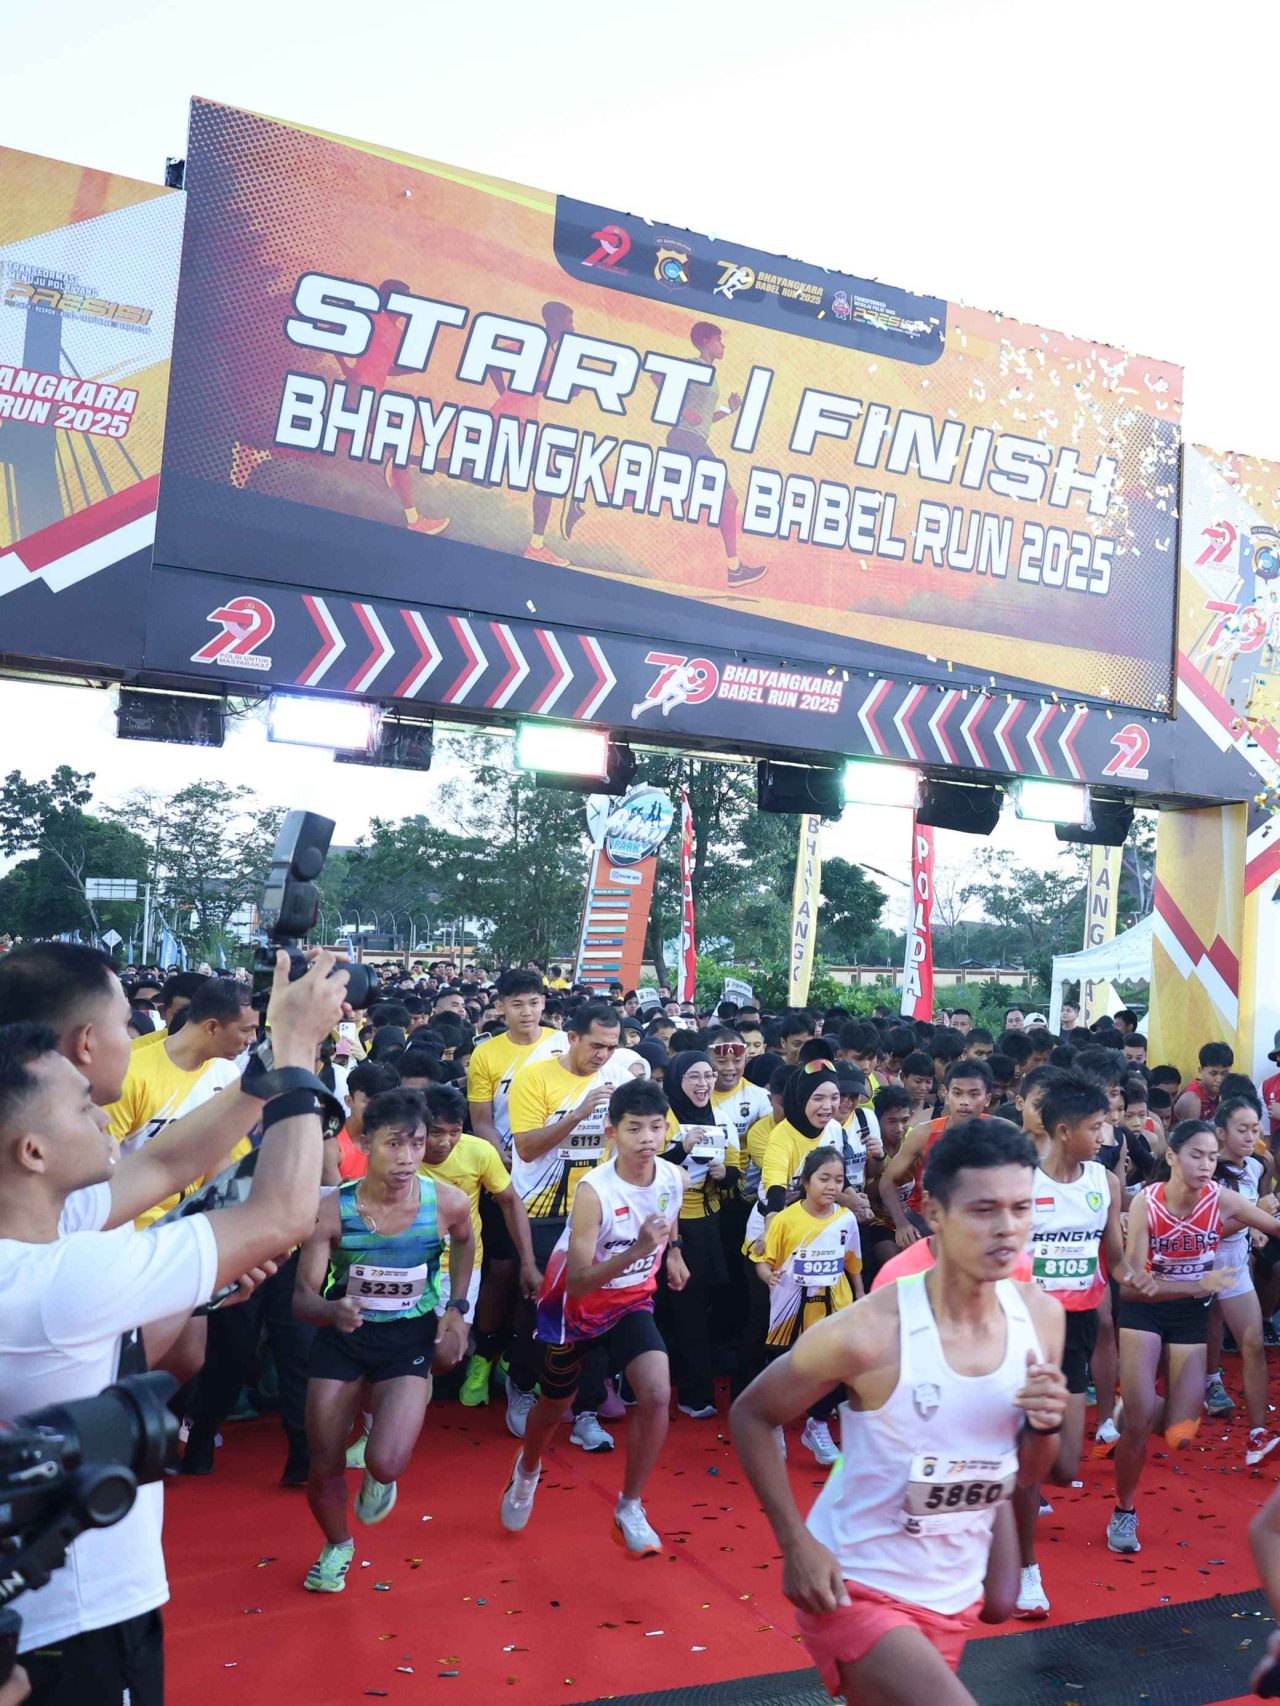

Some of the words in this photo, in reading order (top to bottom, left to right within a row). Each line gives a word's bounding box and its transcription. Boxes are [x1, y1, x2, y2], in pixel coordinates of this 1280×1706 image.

[8, 271, 46, 288] MENUJU
[757, 272, 824, 297] BHAYANGKARA
[6, 282, 153, 326] PRESISI
[755, 281, 779, 295] BABEL
[799, 292, 822, 305] 2025
[287, 273, 714, 425] START
[789, 388, 1119, 515] FINISH
[54, 404, 131, 439] 2025
[274, 371, 727, 527] BHAYANGKARA
[742, 466, 906, 562] BABEL
[912, 499, 1013, 578] RUN
[1017, 522, 1115, 595] 2025
[220, 658, 269, 669] MASYARAKAT
[723, 665, 843, 697] BHAYANGKARA
[718, 682, 764, 704] BABEL
[767, 689, 798, 708] RUN
[799, 694, 840, 714] 2025
[907, 834, 929, 999] POLDA
[571, 1135, 601, 1147] 6113
[803, 1260, 838, 1273] 9022
[1045, 1260, 1088, 1274] 8105
[1163, 1264, 1205, 1274] 7209
[360, 1281, 413, 1296] 5233
[925, 1483, 1003, 1509] 5860
